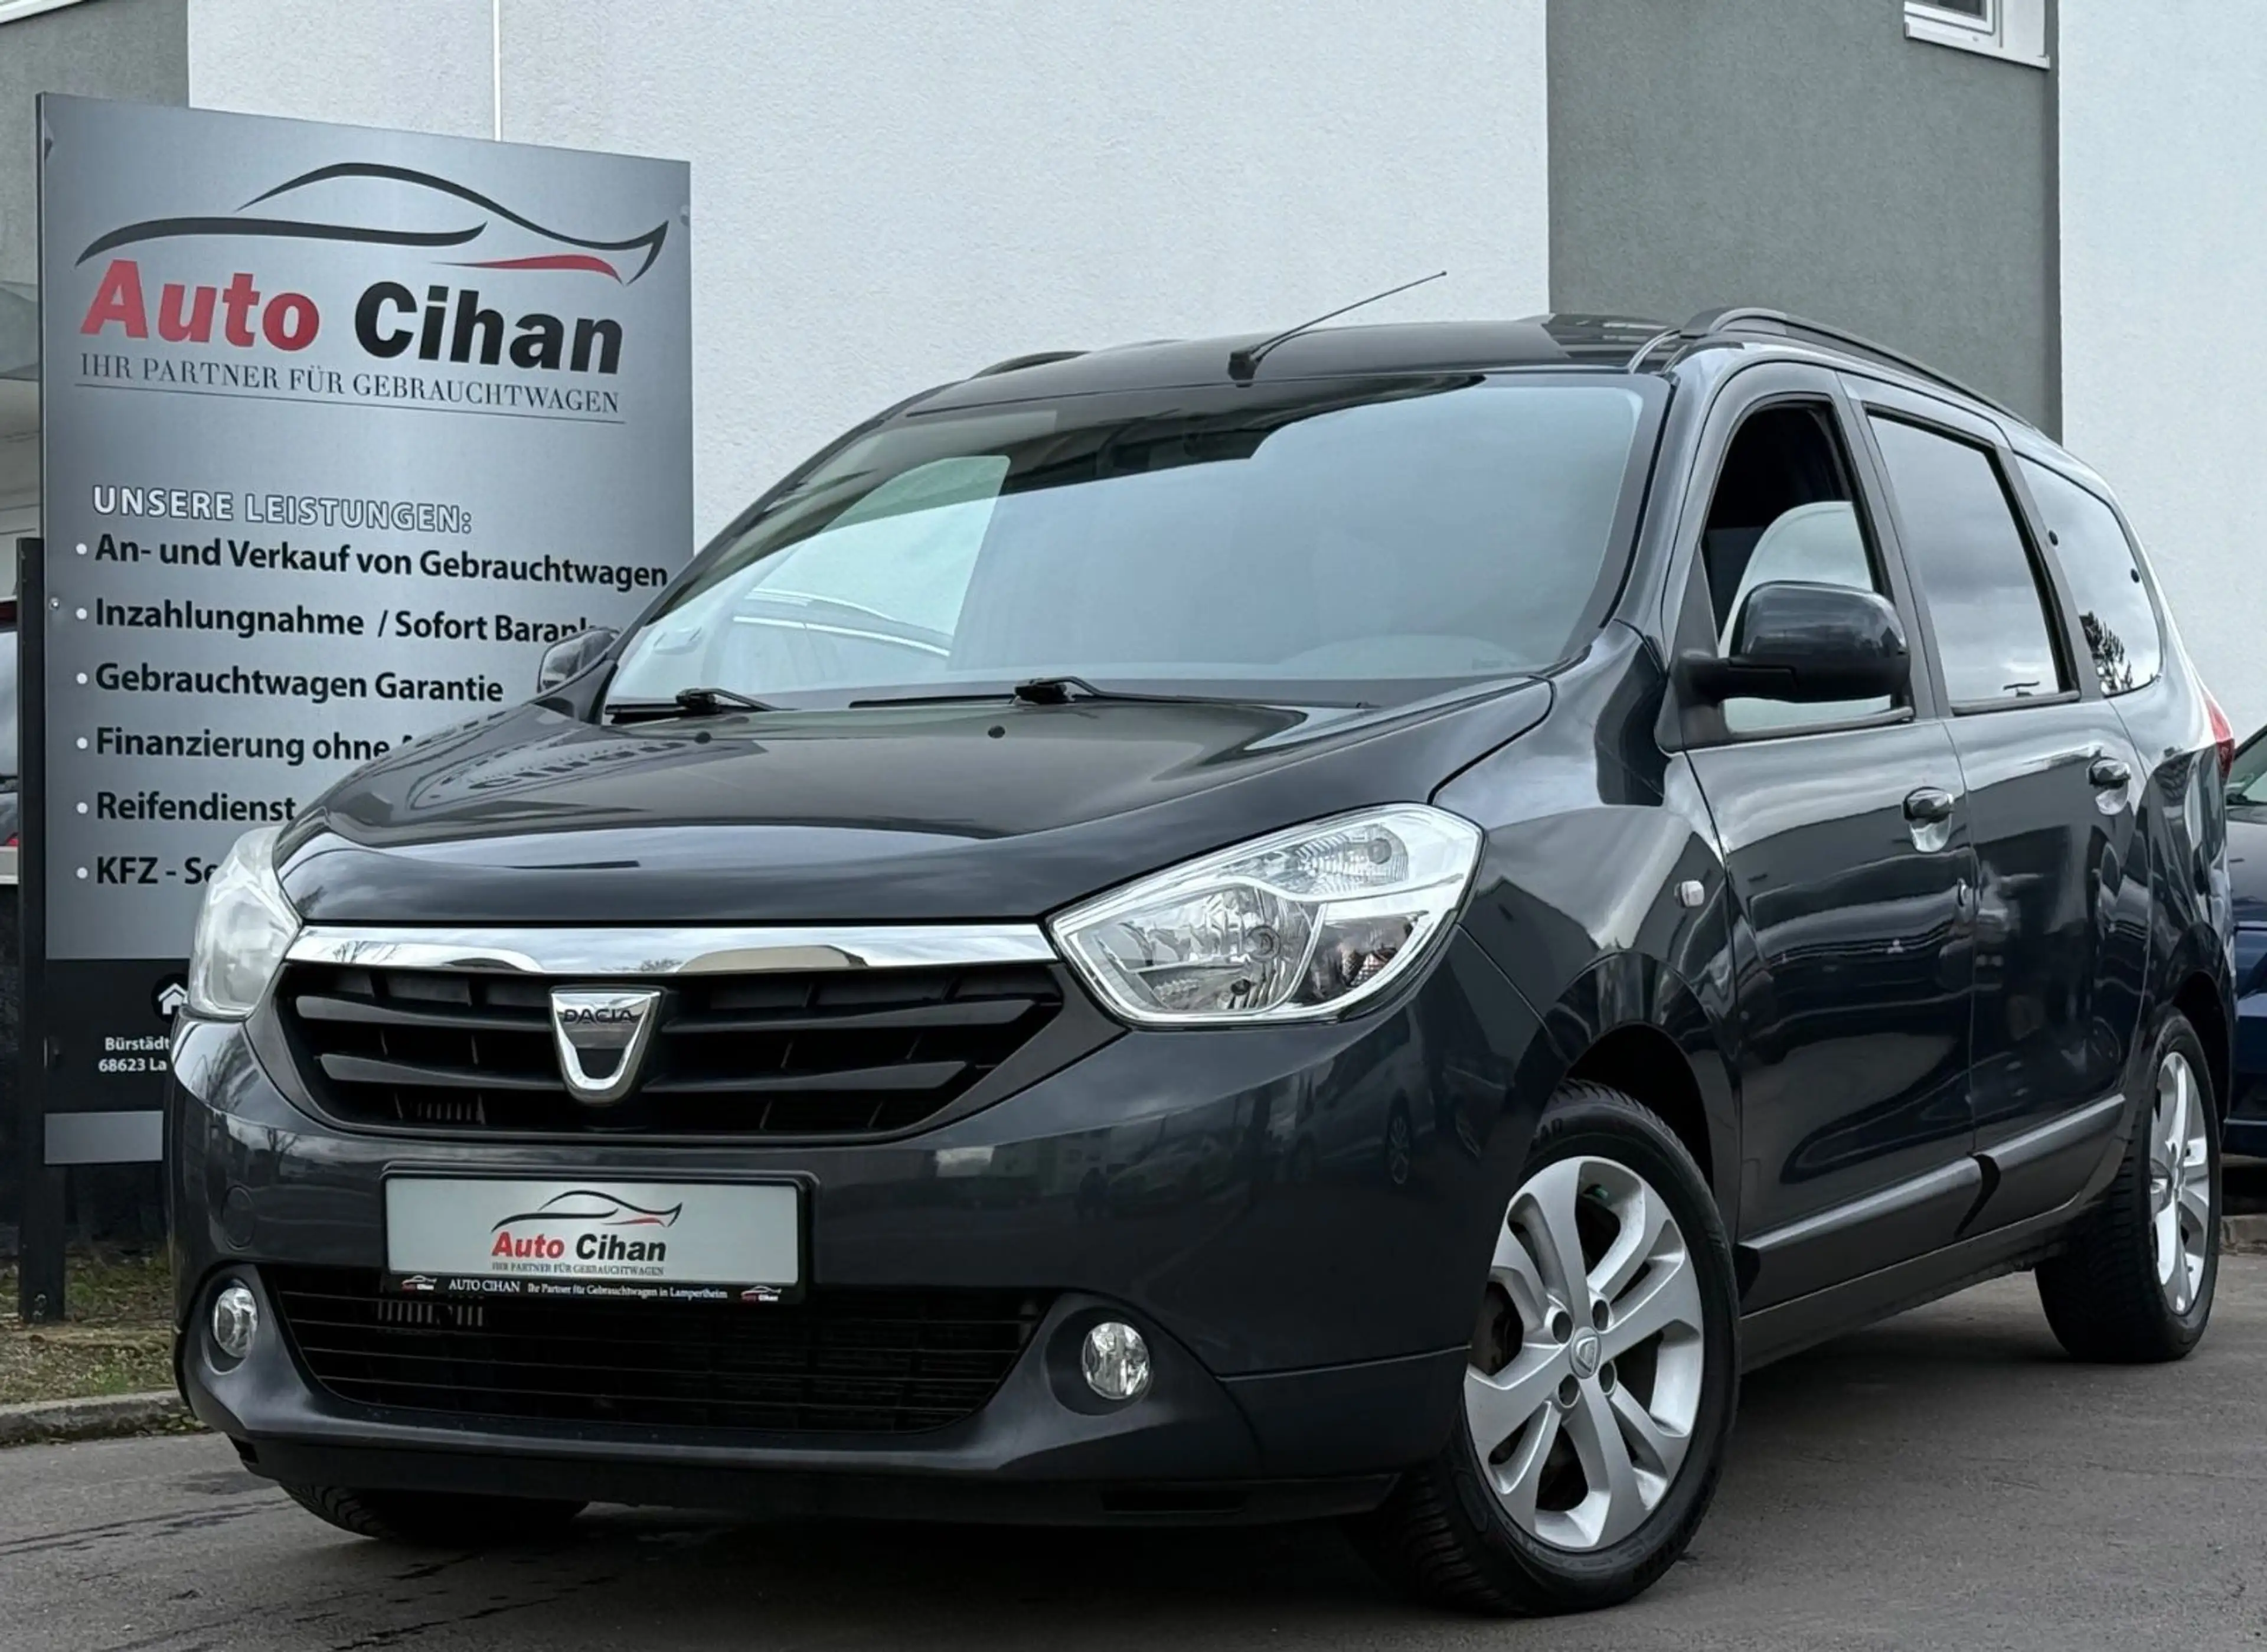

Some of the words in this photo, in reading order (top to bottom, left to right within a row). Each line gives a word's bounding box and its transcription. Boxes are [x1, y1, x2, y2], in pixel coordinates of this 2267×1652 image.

[81, 259, 319, 351] Auto
[355, 282, 623, 375] Cihan
[81, 353, 131, 379] IHR
[142, 361, 279, 390] PARTNER
[288, 365, 345, 395] FÜR
[352, 373, 619, 414] GEBRAUCHTWAGEN
[92, 484, 234, 521] UNSERE
[244, 494, 473, 534] LEISTUNGEN:
[95, 533, 151, 562] An-
[160, 538, 221, 566] und
[227, 540, 351, 572] Verkauf
[356, 553, 411, 575] von
[420, 550, 669, 592] Gebrauchtwagen
[96, 597, 364, 639] Inzahlungnahme
[396, 610, 488, 641] Sofort
[95, 662, 367, 704] Gebrauchtwagen
[375, 672, 504, 702] Garantie
[96, 726, 304, 766] Finanzierung
[96, 791, 296, 822] Reifendienst
[97, 856, 158, 884] KFZ
[563, 1008, 635, 1024] DACIA
[98, 1058, 146, 1072] 68623
[492, 1232, 564, 1258] Auto
[576, 1233, 667, 1262] Cihan
[511, 1262, 551, 1273] PARTNER
[553, 1262, 572, 1274] FÜR
[573, 1265, 665, 1276] GEBRAUCHTWAGEN
[448, 1278, 481, 1291] AUTO
[482, 1279, 521, 1293] CIHAN
[528, 1283, 540, 1293] Ihr
[542, 1284, 571, 1294] Partner
[573, 1284, 584, 1294] für
[586, 1284, 658, 1300] Gebrauchtwagen
[659, 1287, 668, 1297] in
[669, 1287, 727, 1301] Lampertheim
